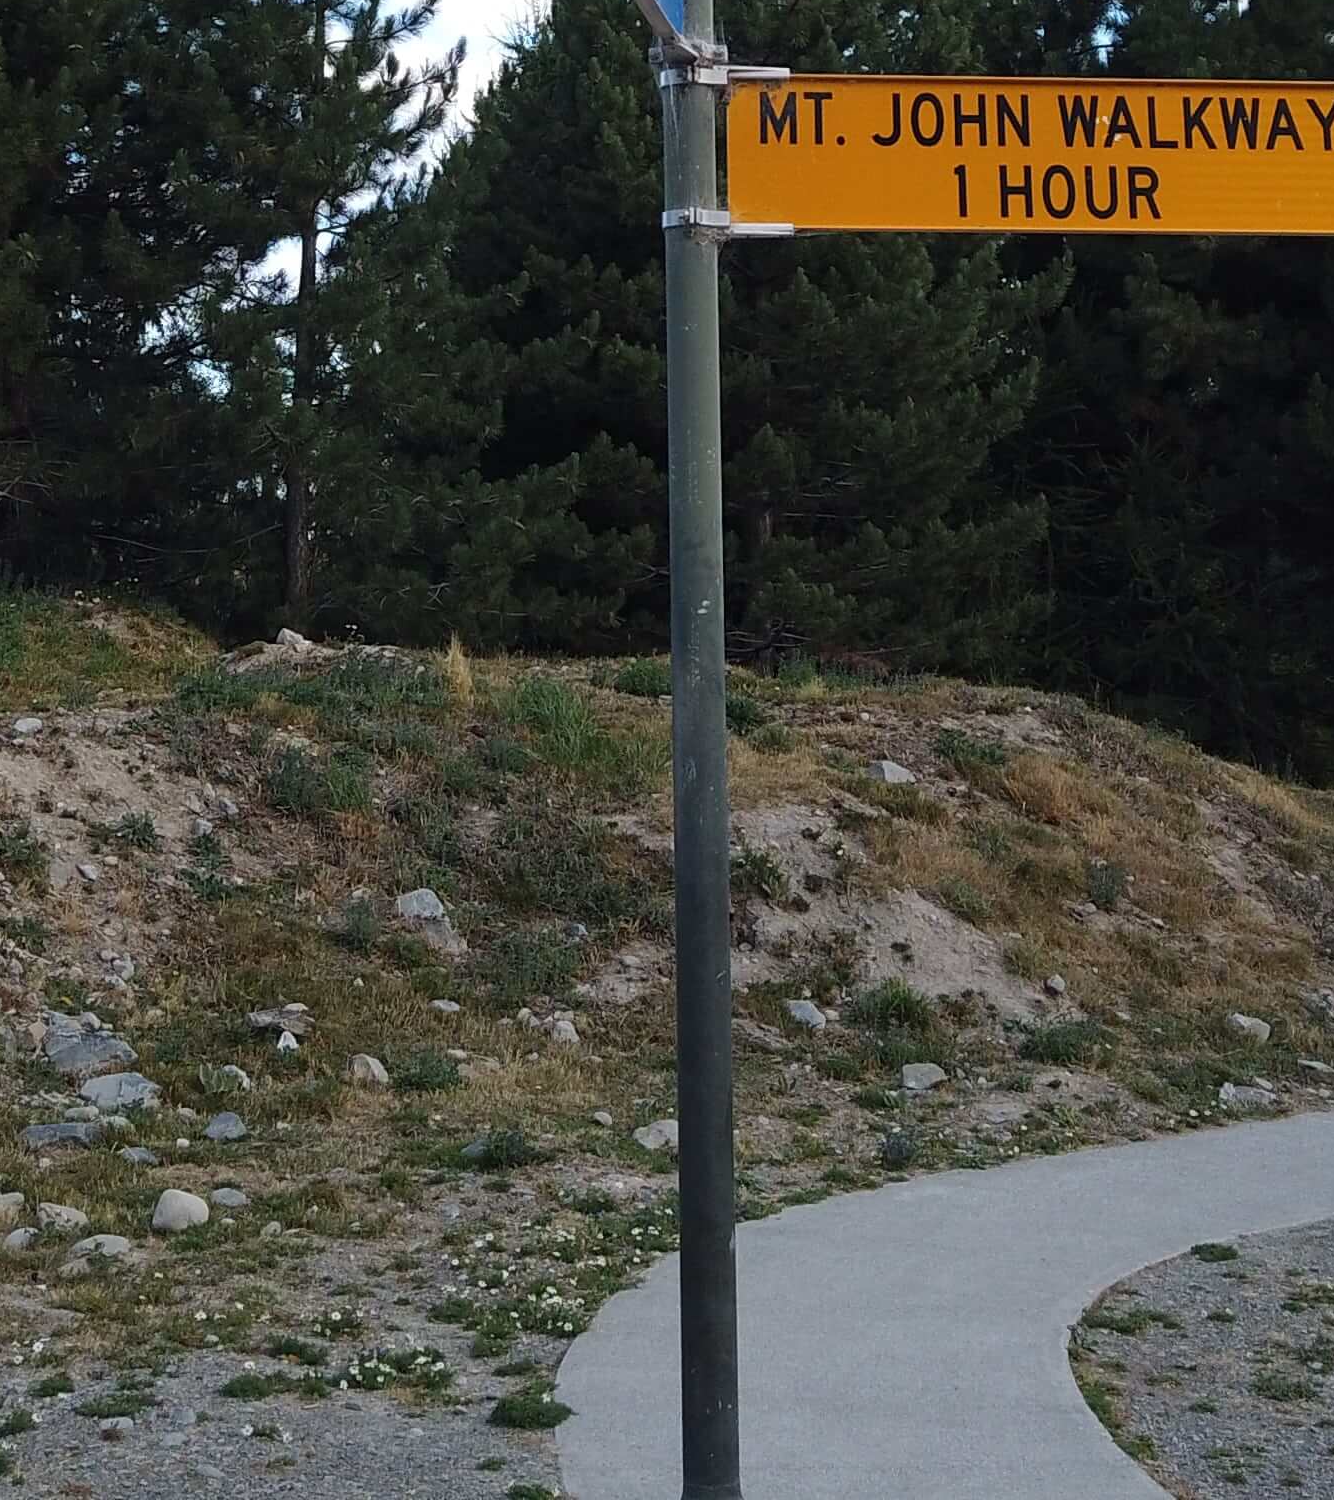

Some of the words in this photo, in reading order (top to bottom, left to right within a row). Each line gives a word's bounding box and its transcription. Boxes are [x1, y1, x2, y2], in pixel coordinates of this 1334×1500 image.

[759, 91, 846, 146] MT.
[871, 92, 1031, 147] JOHN
[953, 163, 968, 218] 1
[998, 163, 1162, 220] HOUR
